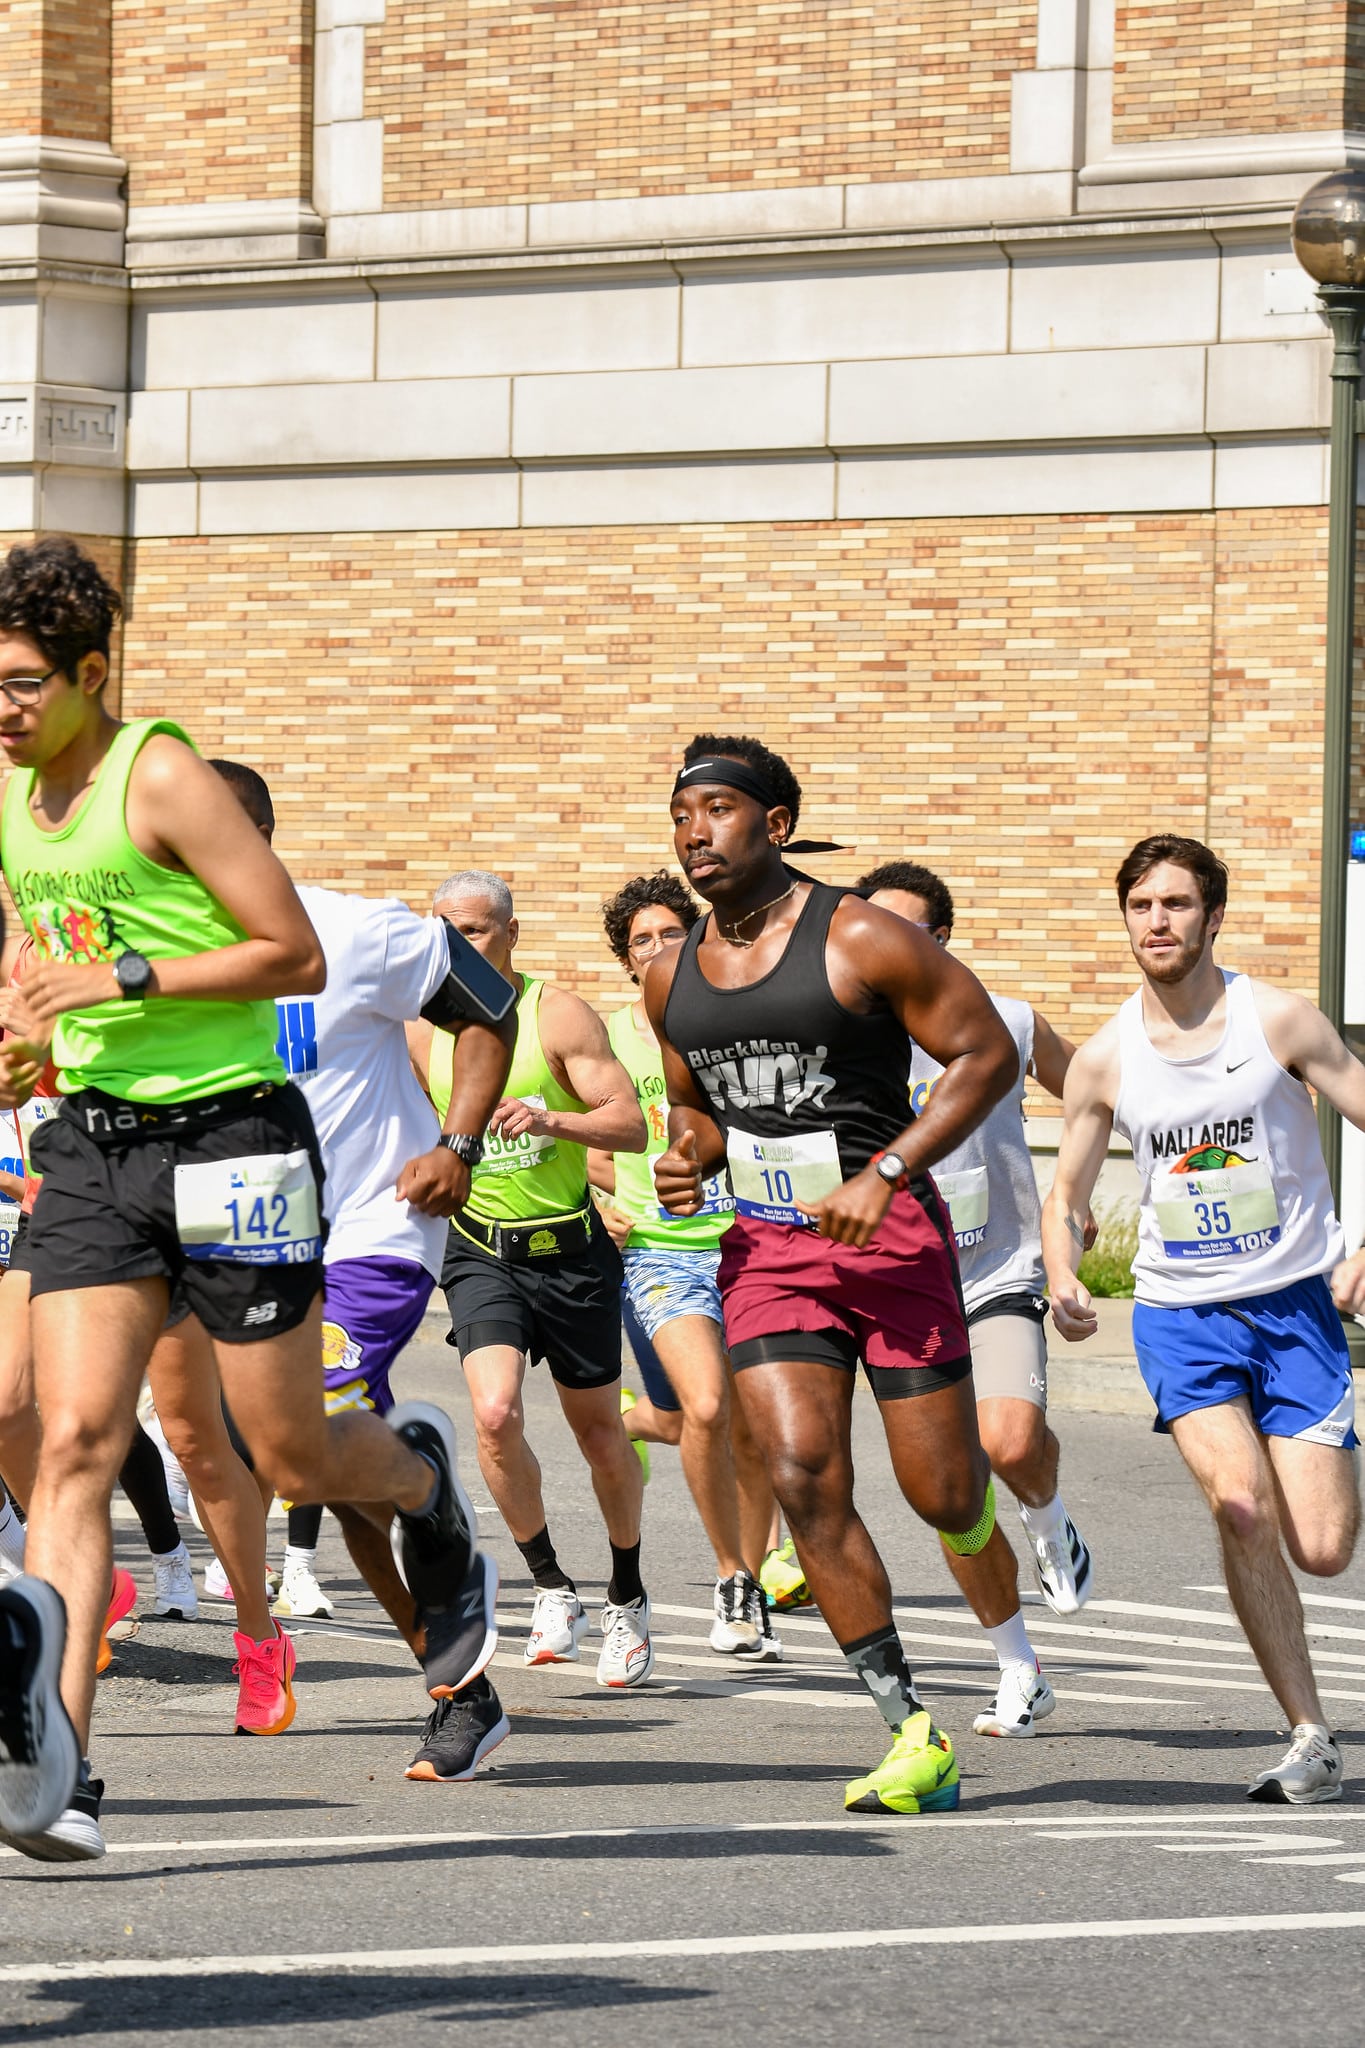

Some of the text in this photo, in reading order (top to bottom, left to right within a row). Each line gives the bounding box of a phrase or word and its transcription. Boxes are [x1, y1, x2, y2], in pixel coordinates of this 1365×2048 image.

[1150, 1116, 1254, 1159] MALLARDS
[520, 1152, 542, 1168] 5K
[760, 1169, 794, 1203] 10
[224, 1194, 291, 1241] 142
[1194, 1201, 1232, 1237] 35
[955, 1227, 985, 1249] 10K
[1235, 1229, 1274, 1253] 10K
